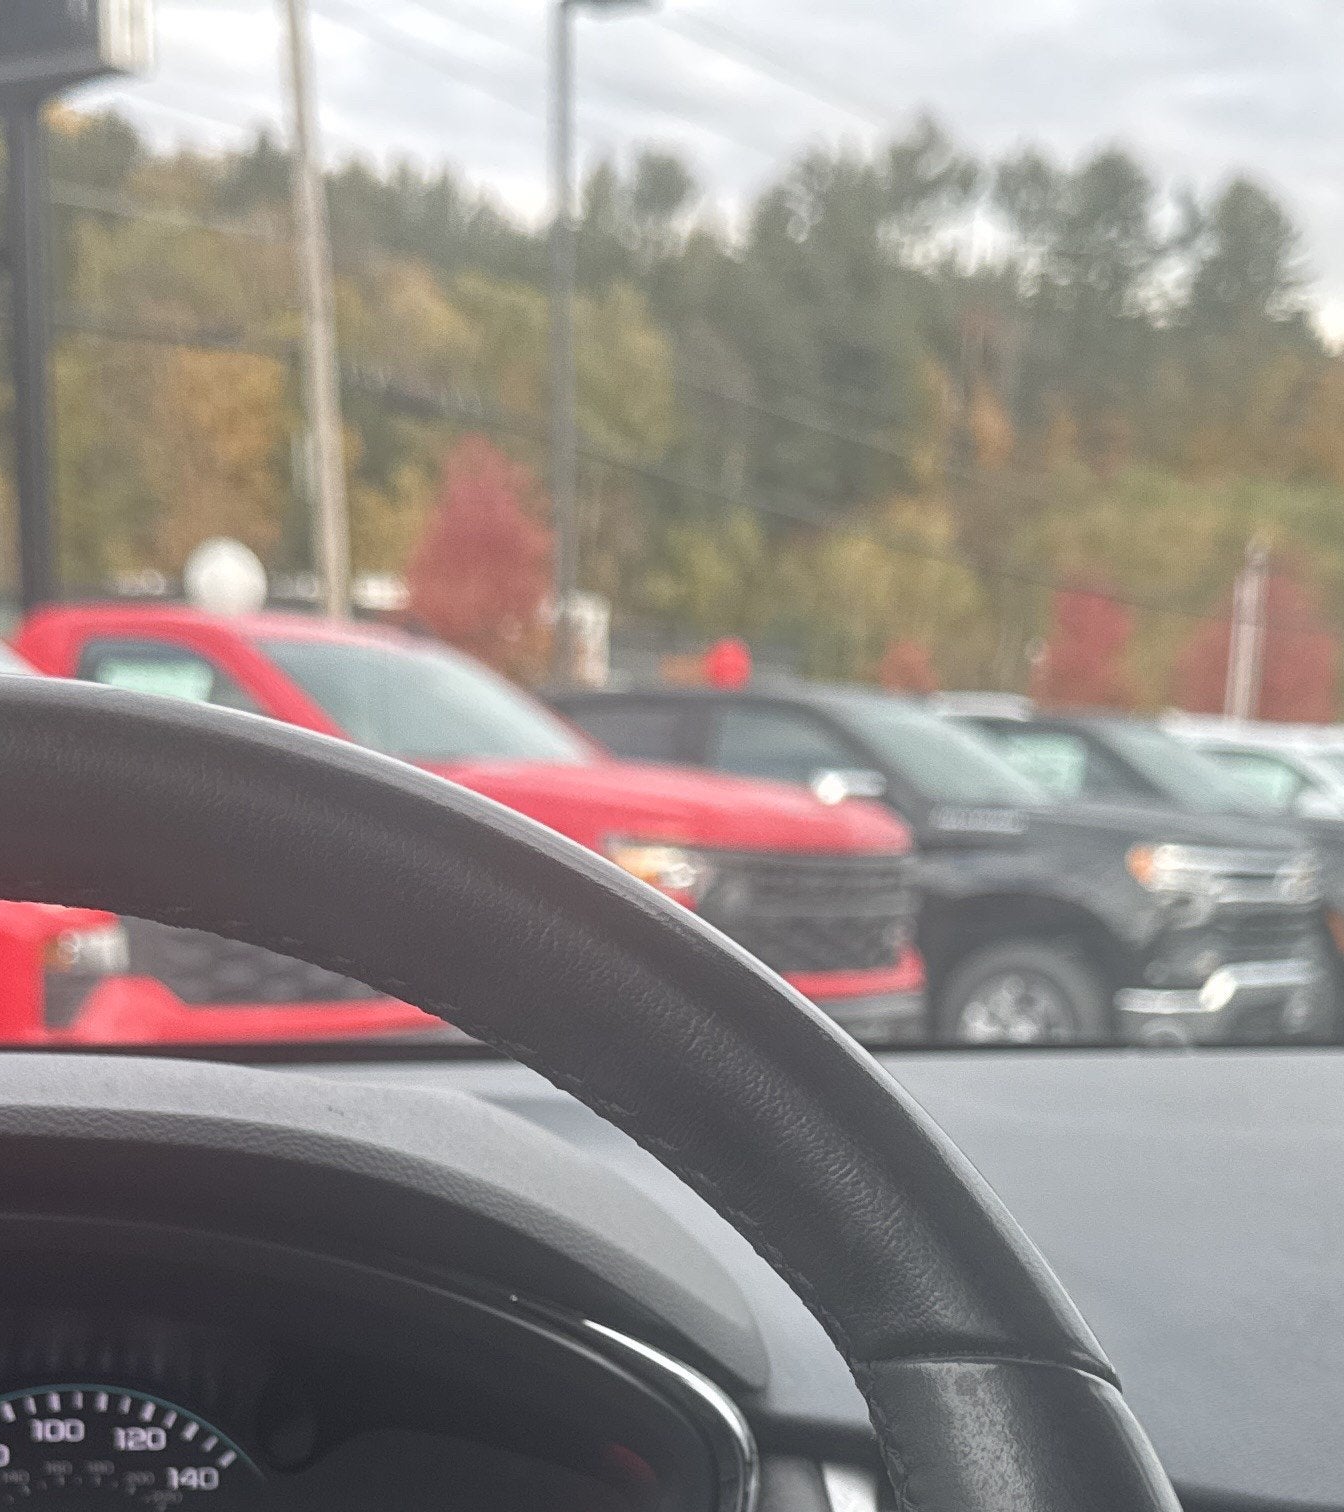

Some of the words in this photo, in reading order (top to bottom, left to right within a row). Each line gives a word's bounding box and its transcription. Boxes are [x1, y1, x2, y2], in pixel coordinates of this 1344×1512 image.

[30, 1418, 85, 1443] 100
[113, 1427, 167, 1451] 120
[167, 1466, 219, 1490] 140
